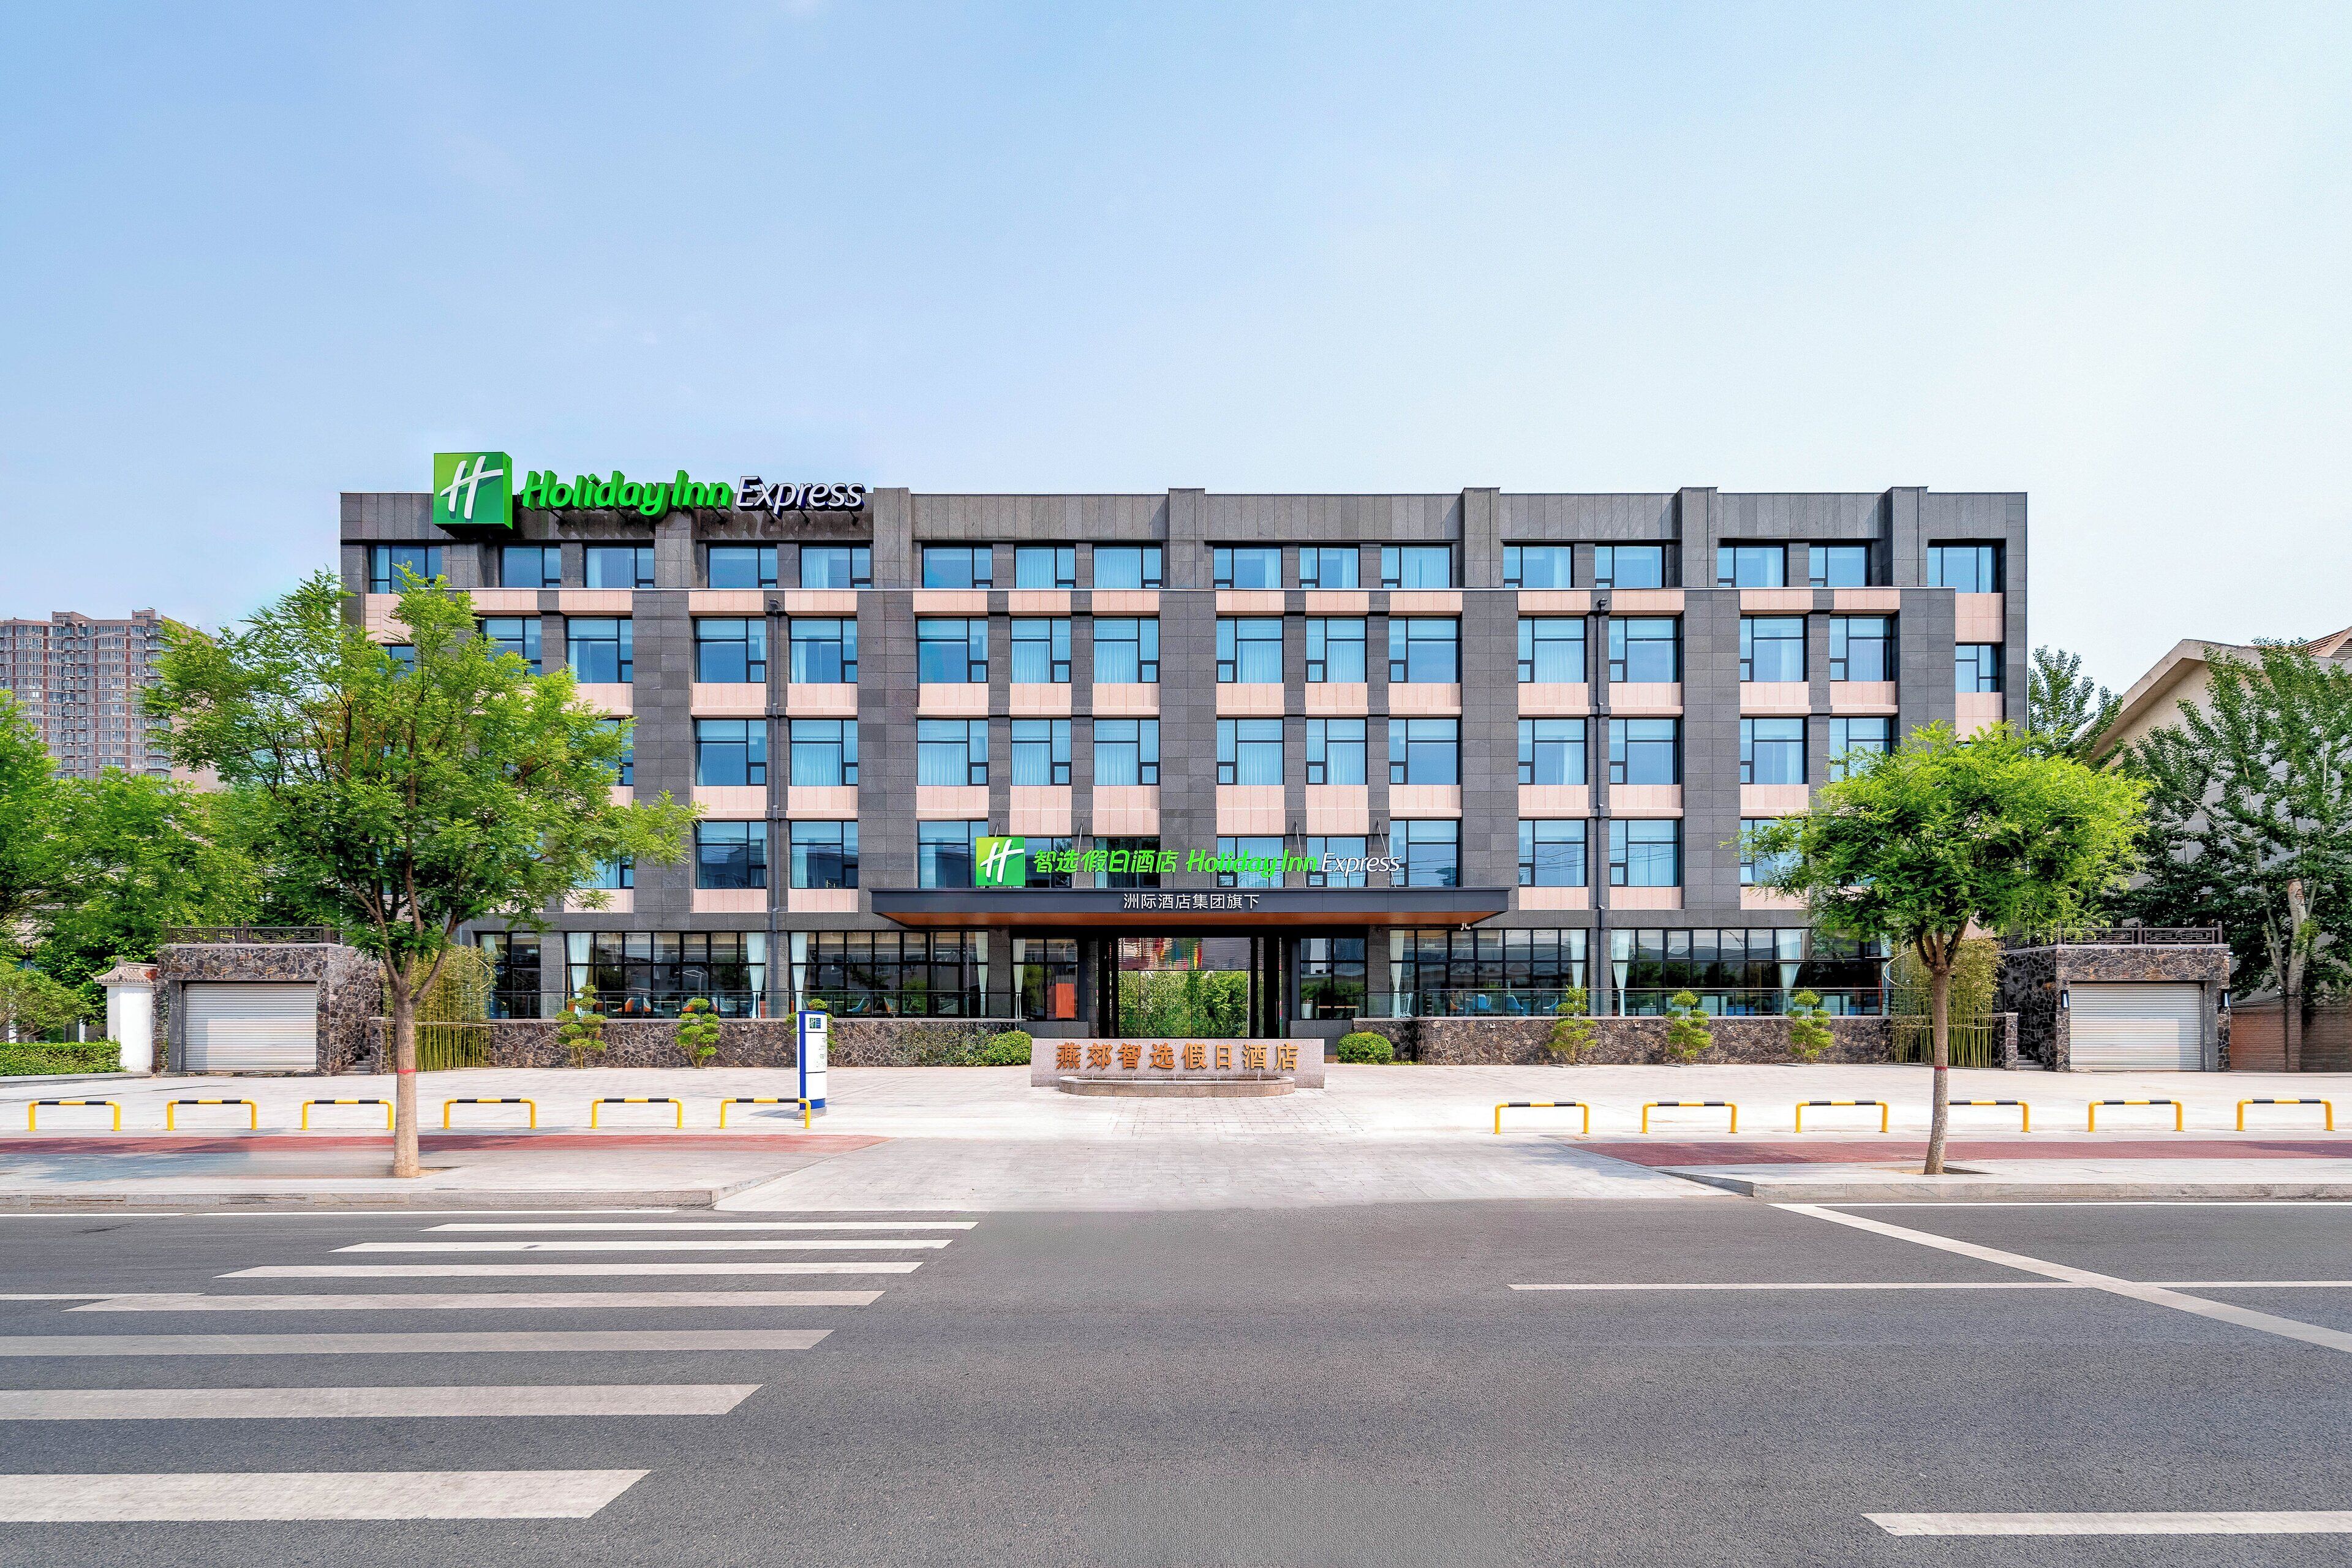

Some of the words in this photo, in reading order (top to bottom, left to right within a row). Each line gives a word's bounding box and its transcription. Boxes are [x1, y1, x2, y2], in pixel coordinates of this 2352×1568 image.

[520, 470, 670, 520] Holiday
[671, 470, 734, 511] Inn
[736, 475, 865, 519] Express
[1033, 849, 1180, 873] 智选假日酒店
[1185, 849, 1278, 878] Holiday
[1281, 849, 1318, 873] Inn
[1321, 852, 1400, 878] Express
[1123, 893, 1260, 910] 洲际酒店集团旗下
[1055, 1041, 1299, 1071] 燕郊智选假日酒店
